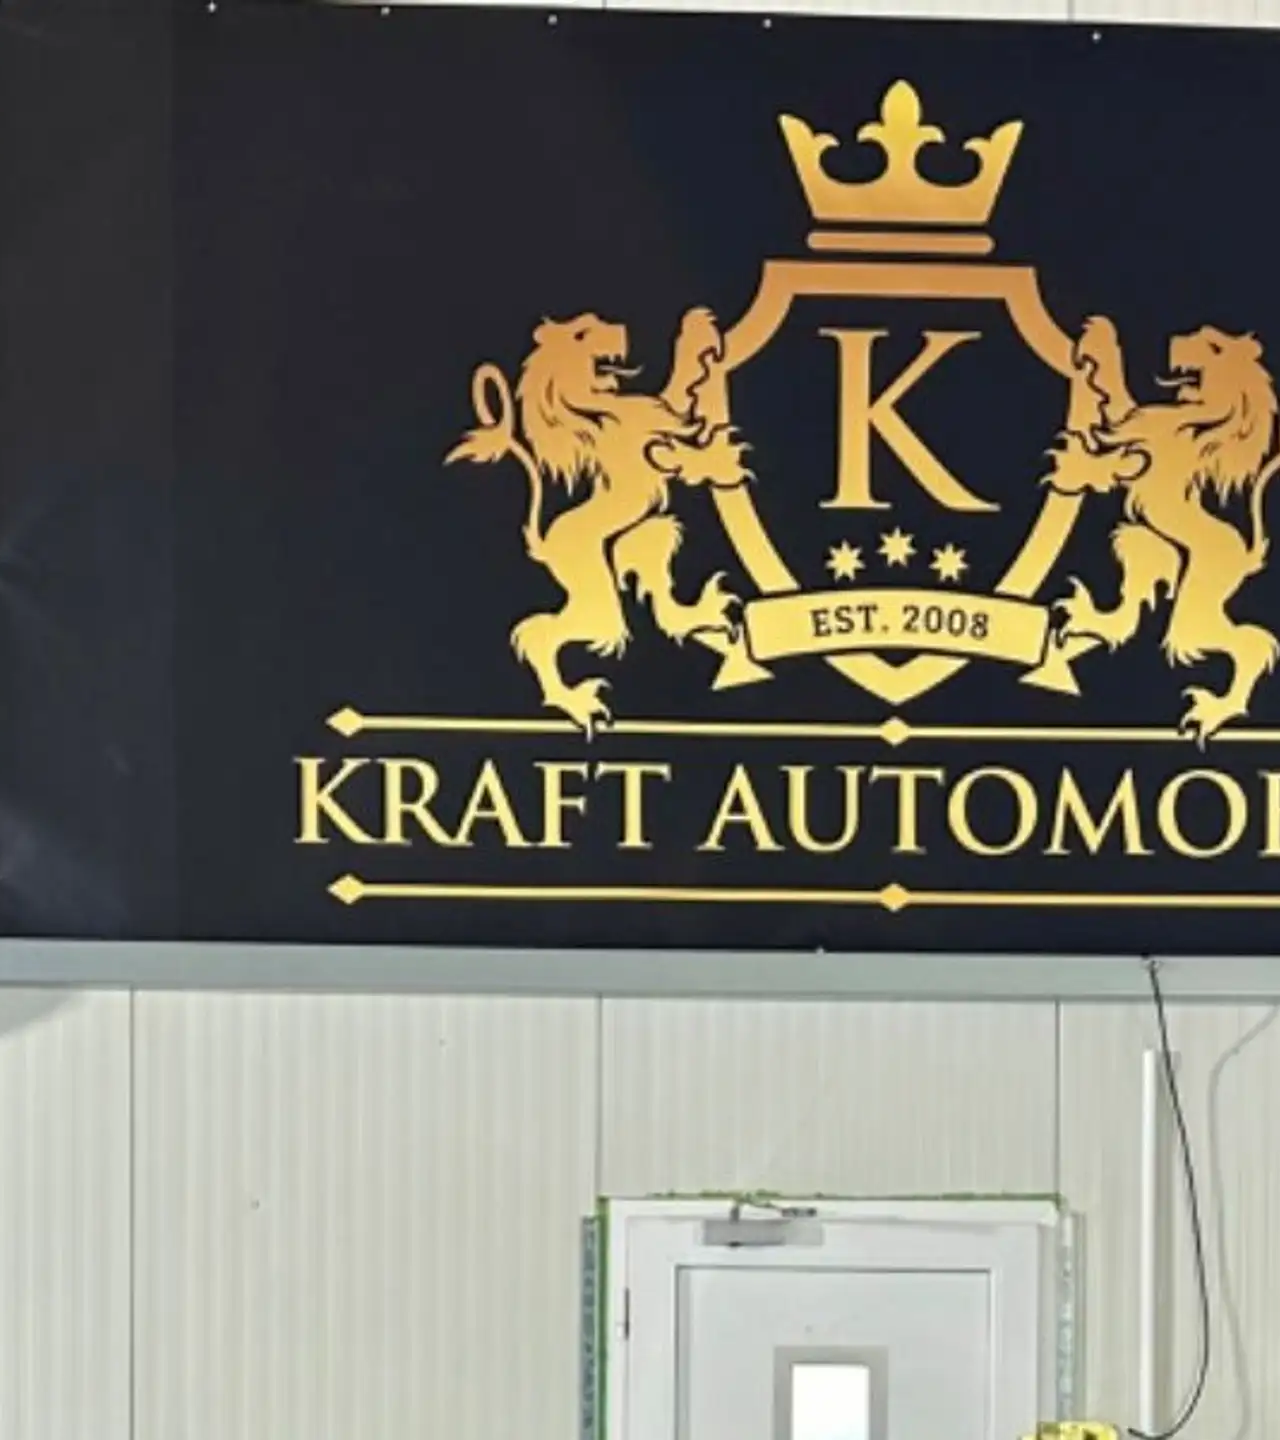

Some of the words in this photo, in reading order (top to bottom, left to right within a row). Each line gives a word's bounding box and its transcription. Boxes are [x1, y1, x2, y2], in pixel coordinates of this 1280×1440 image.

[819, 328, 1000, 512] K
[809, 604, 890, 638] EST.
[902, 604, 990, 641] 2008
[293, 756, 672, 850] KRAFT
